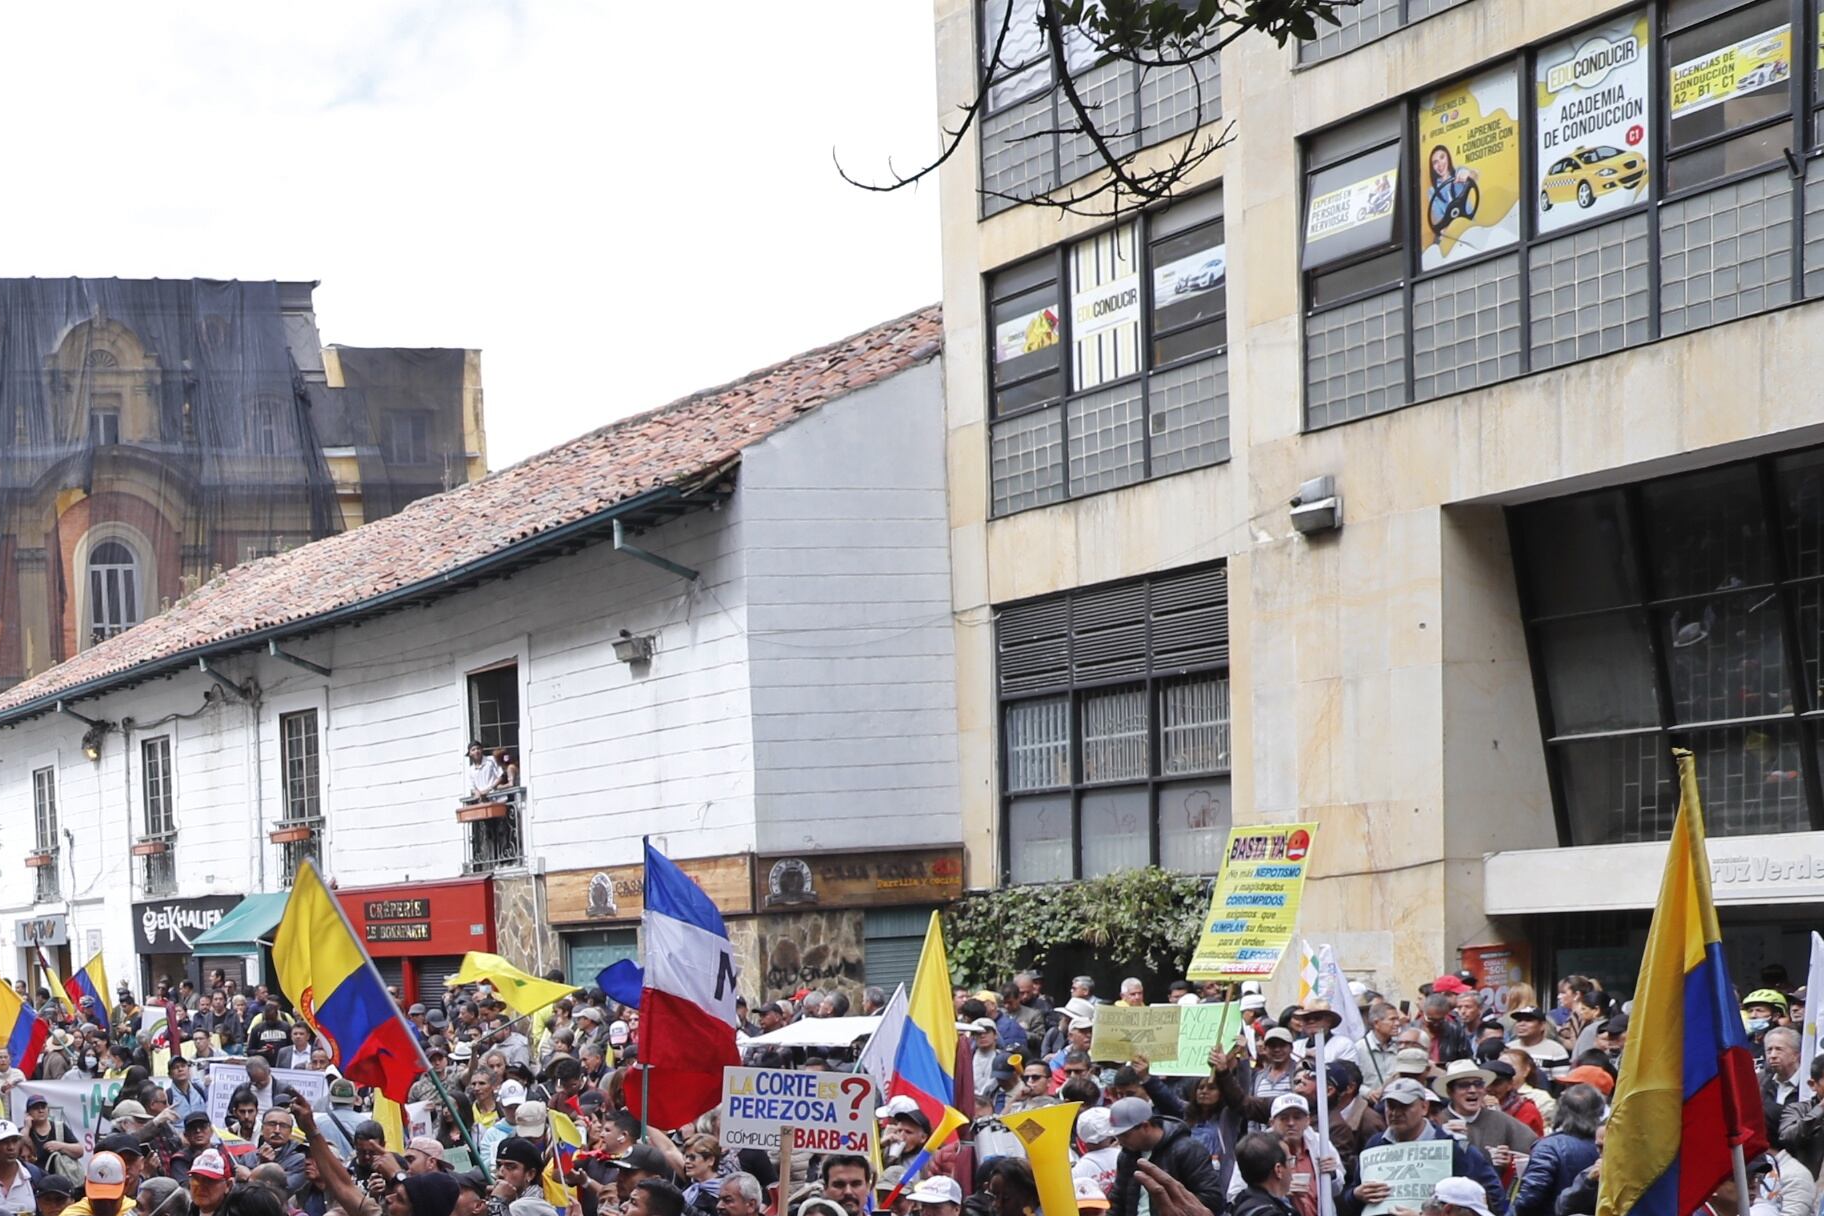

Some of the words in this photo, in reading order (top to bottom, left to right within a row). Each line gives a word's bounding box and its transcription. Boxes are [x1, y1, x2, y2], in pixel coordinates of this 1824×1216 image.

[1674, 56, 1721, 82] LICENCIAS
[1723, 50, 1735, 62] DE
[1673, 92, 1687, 106] A2
[1698, 83, 1711, 99] B1
[1722, 74, 1735, 89] C1
[1560, 83, 1625, 124] ACADEMIA
[1544, 130, 1558, 149] DE
[1562, 96, 1643, 143] CONDUCCIÓN
[1455, 145, 1461, 156] A
[1462, 132, 1498, 154] CONDUCIR
[1498, 126, 1514, 142] CON
[1628, 129, 1641, 143] C1
[1311, 200, 1351, 223] PERSONAS
[1310, 212, 1350, 234] NERVIOSAS
[1254, 867, 1302, 878] NEPOTISMO
[1239, 882, 1285, 893] magistrados
[1210, 921, 1246, 933] CUMPLAN
[1242, 937, 1265, 946] orden
[1184, 1008, 1208, 1023] NO
[729, 1075, 754, 1095] LA
[756, 1072, 817, 1098] CORTE
[818, 1082, 839, 1099] ES
[729, 1096, 838, 1123] PEREZOSA
[727, 1129, 781, 1148] CÓMPLICE
